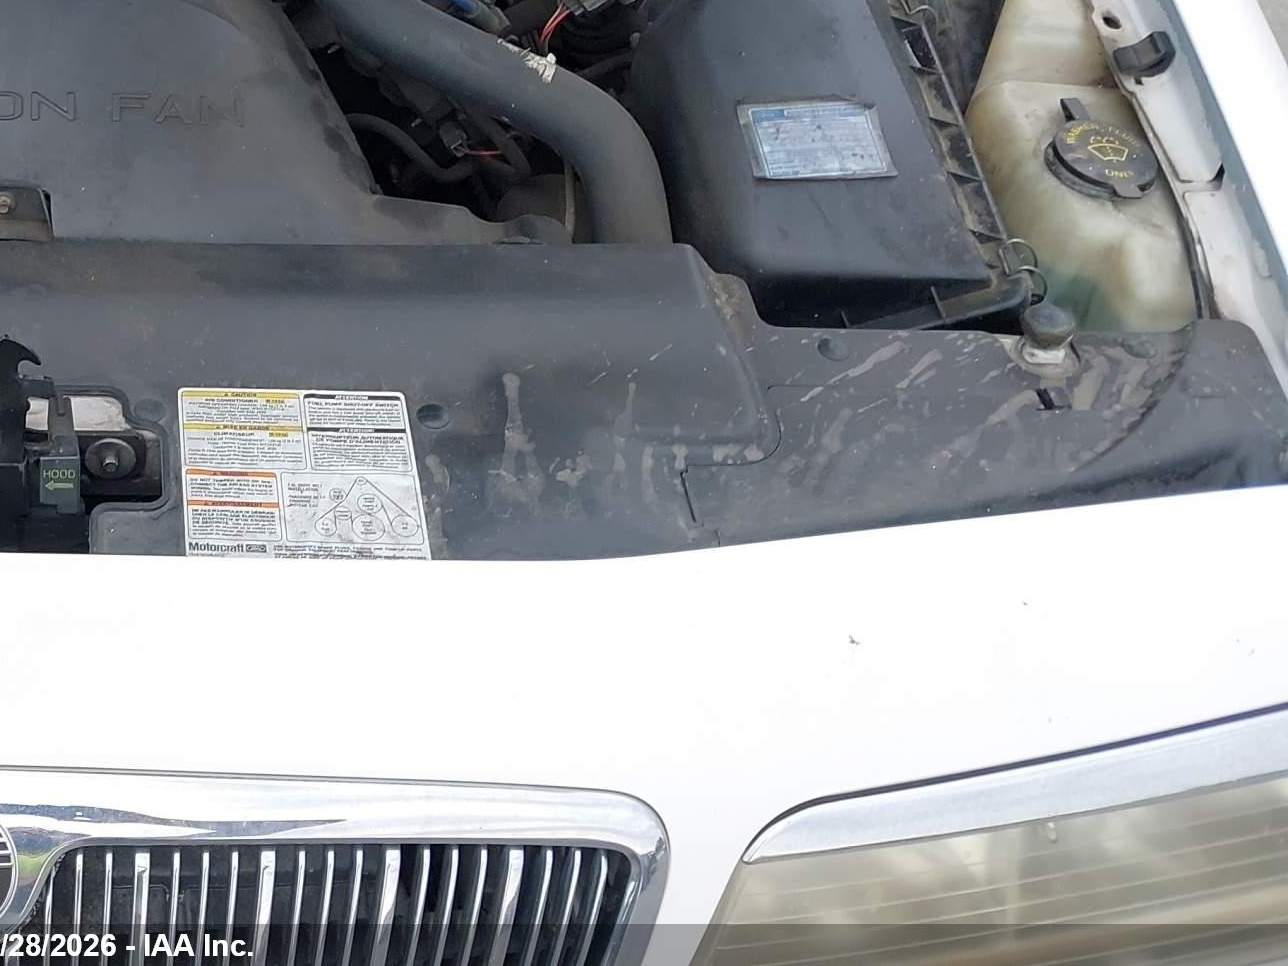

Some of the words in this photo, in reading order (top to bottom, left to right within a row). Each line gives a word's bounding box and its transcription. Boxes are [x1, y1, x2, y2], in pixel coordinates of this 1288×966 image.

[112, 90, 246, 127] FAN
[1104, 168, 1135, 179] ONLY
[43, 469, 76, 479] HOOD
[188, 541, 244, 553] Motorcraft
